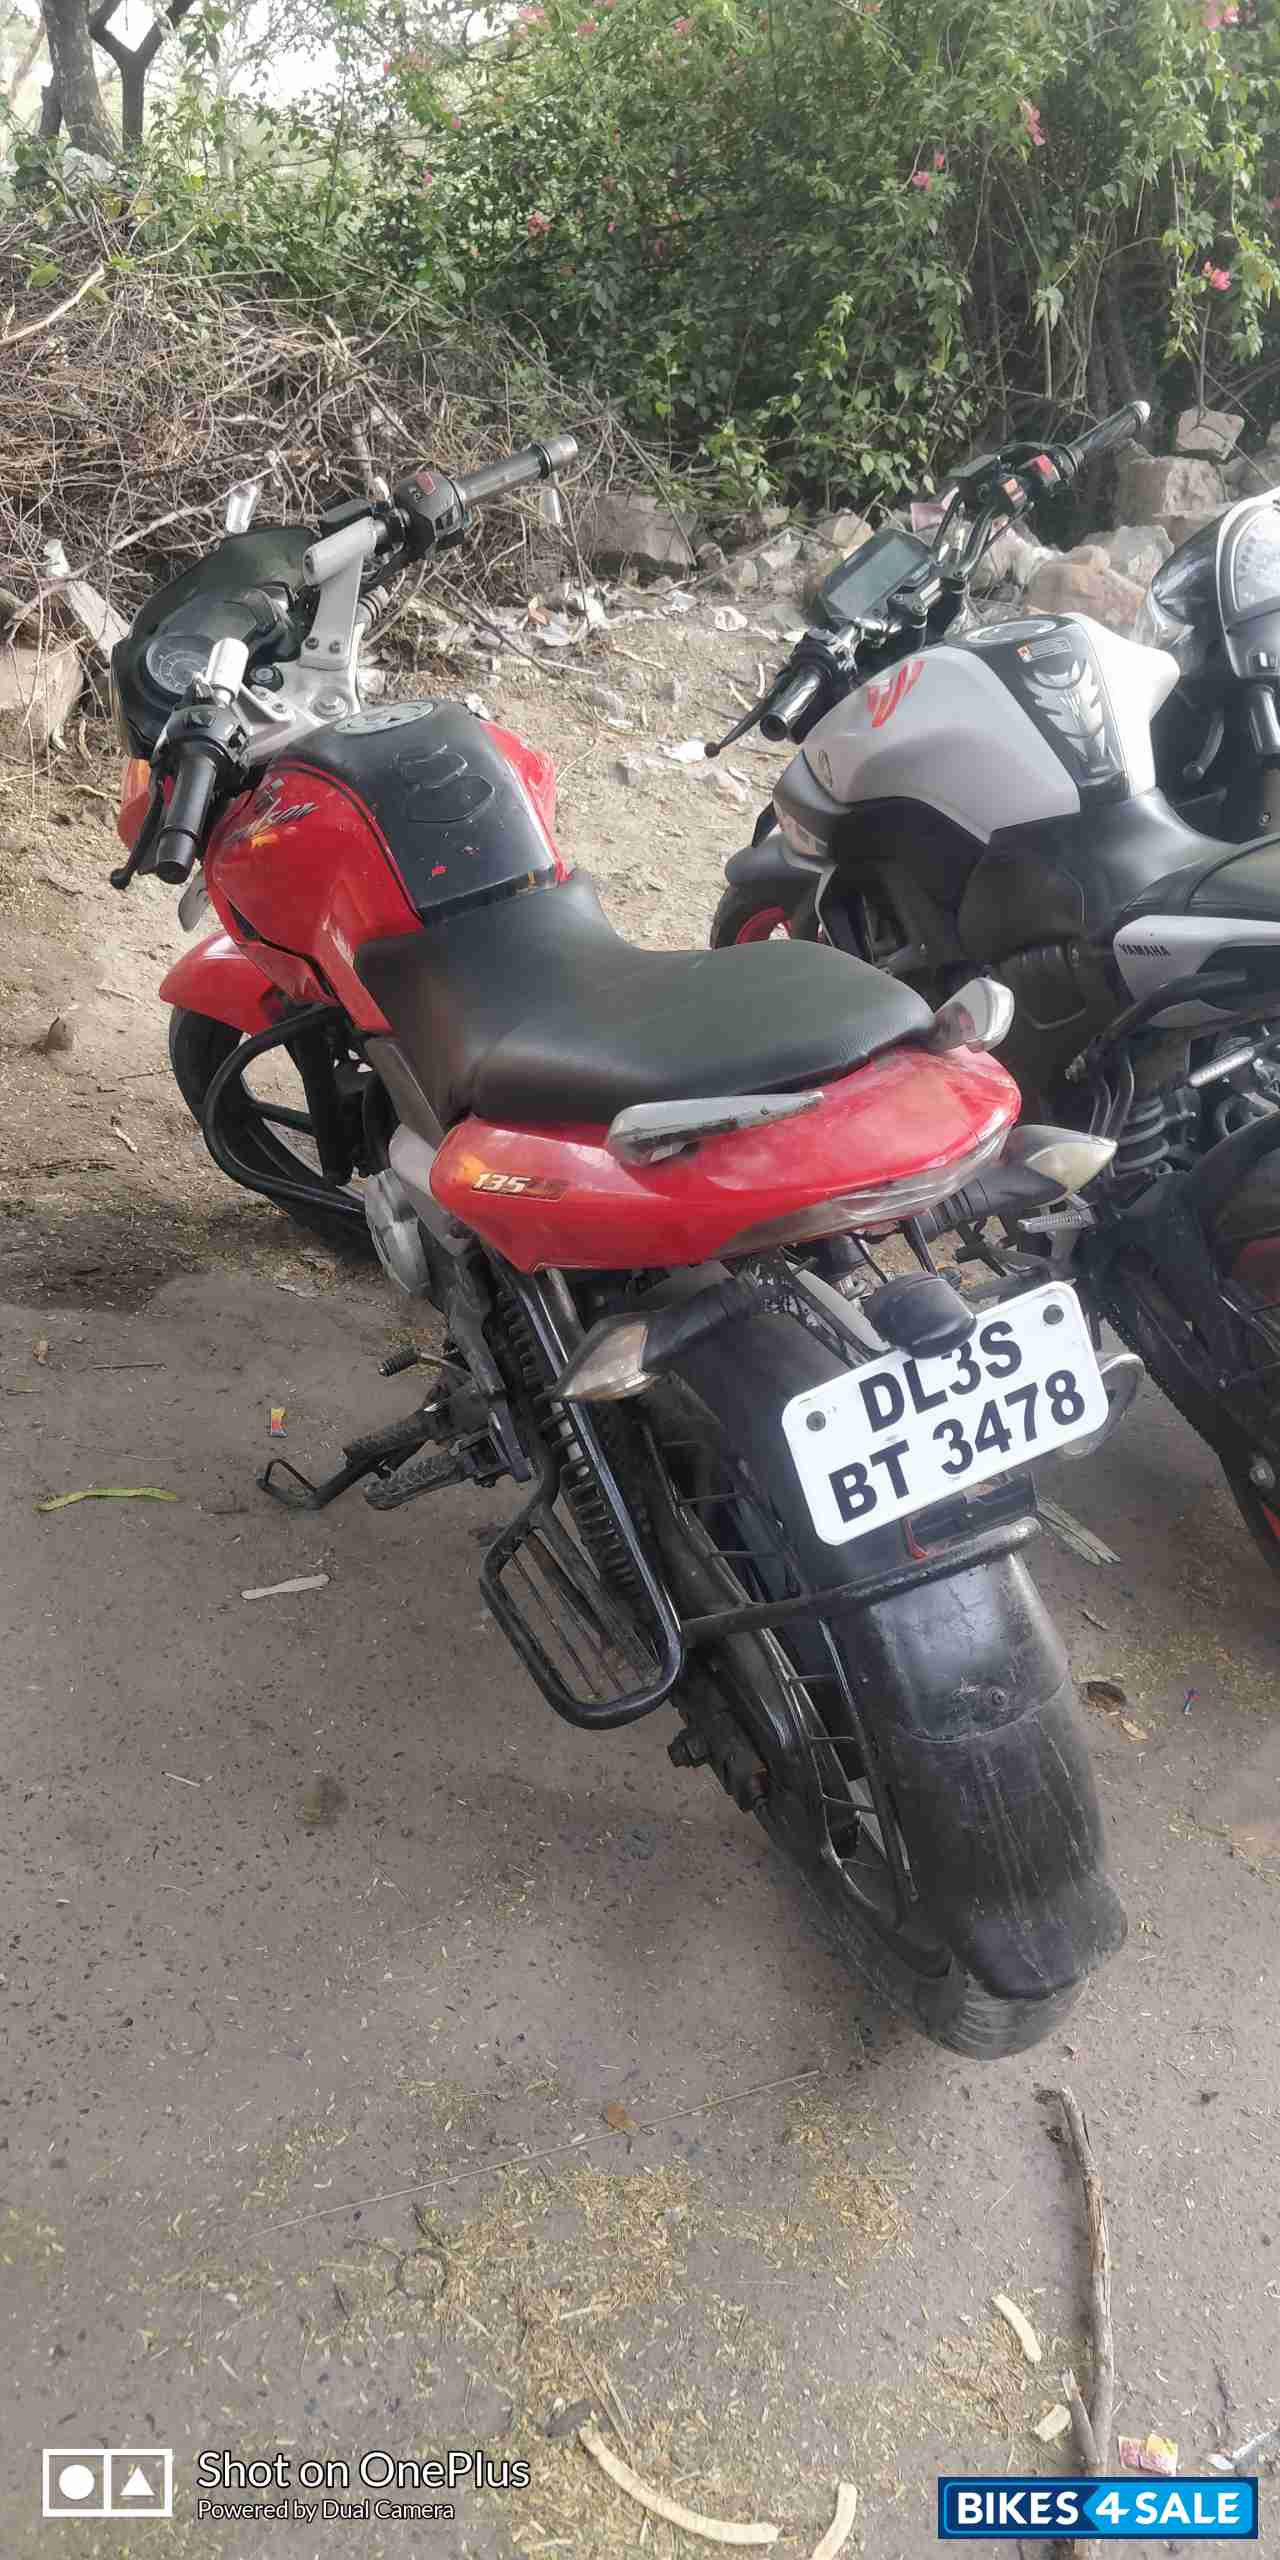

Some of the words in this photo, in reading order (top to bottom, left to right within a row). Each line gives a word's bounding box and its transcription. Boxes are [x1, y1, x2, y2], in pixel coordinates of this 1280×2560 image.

[1119, 944, 1171, 957] YAMAHA
[473, 1172, 531, 1194] 135
[858, 1320, 1022, 1433] DL3S
[828, 1440, 910, 1523] BT
[932, 1370, 1086, 1475] 3478
